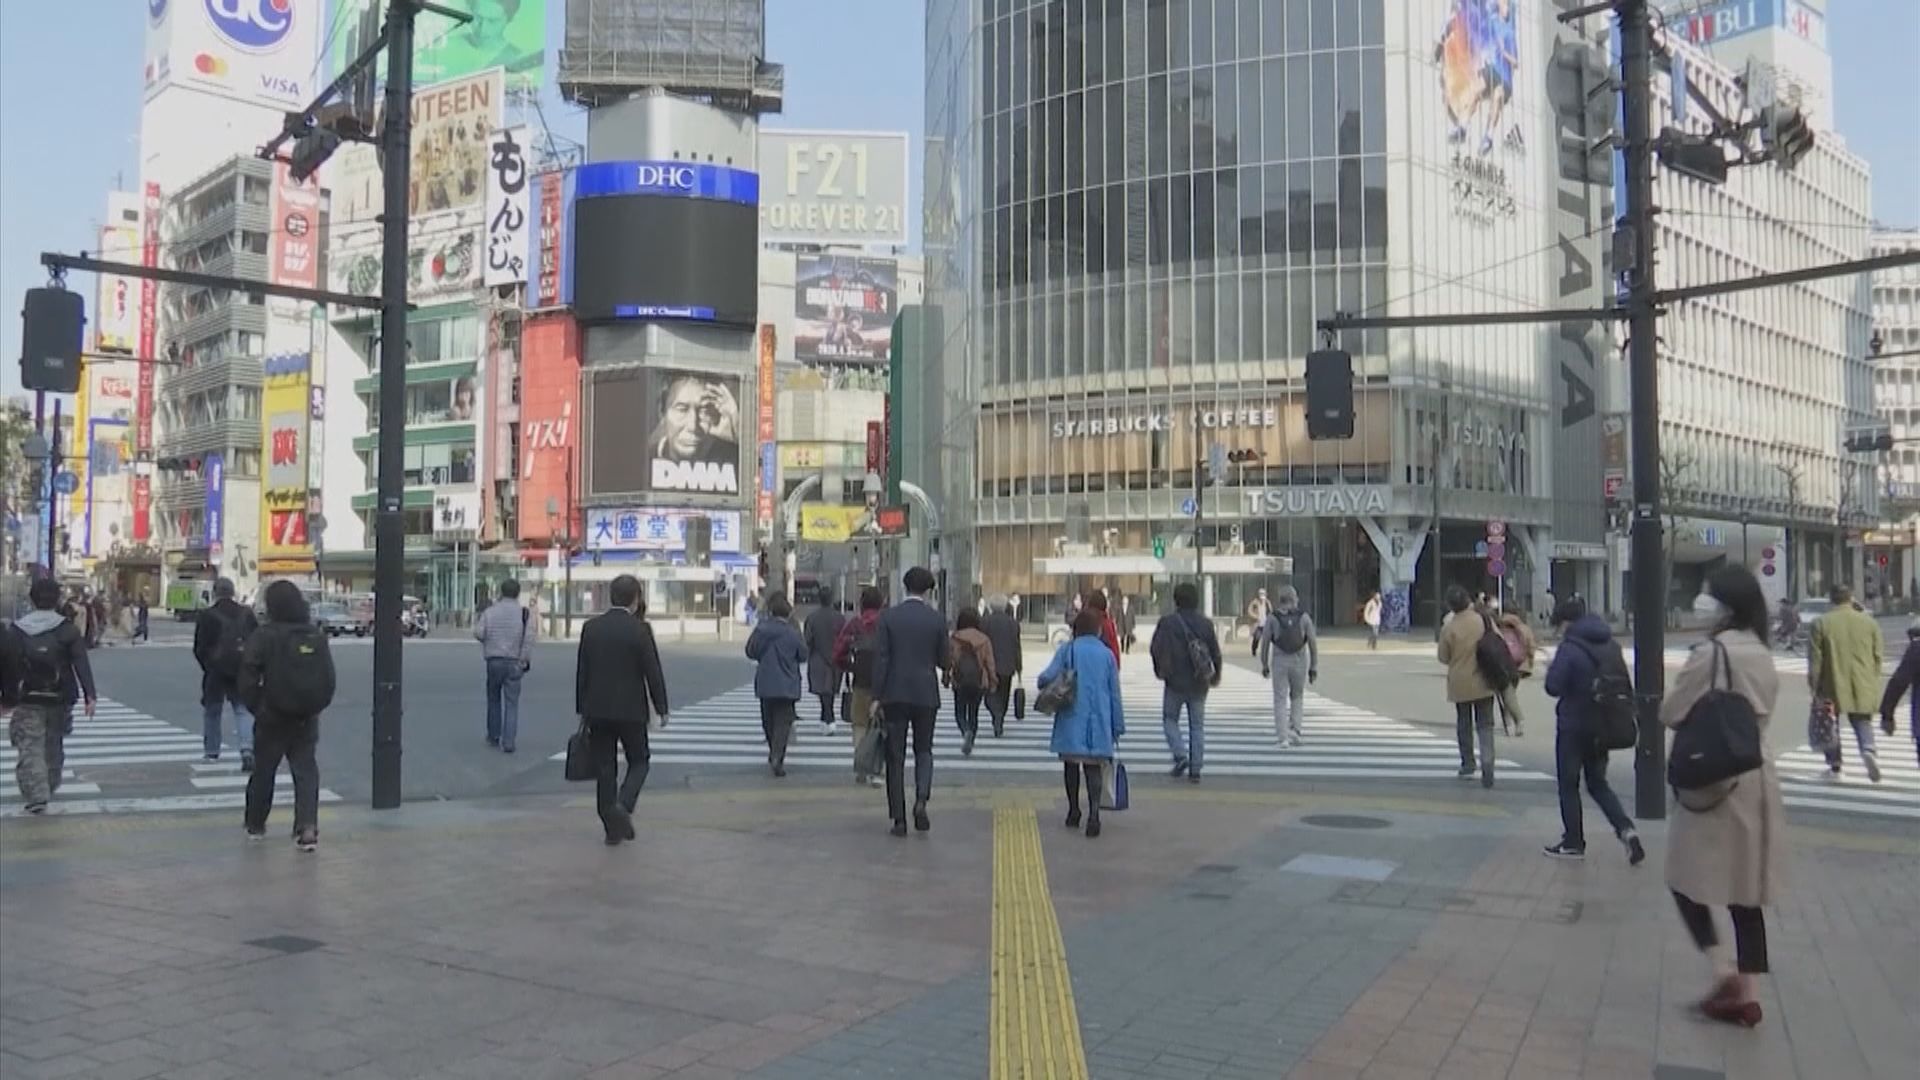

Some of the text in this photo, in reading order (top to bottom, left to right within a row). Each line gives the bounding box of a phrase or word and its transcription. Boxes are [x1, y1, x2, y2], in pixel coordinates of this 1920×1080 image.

[261, 74, 300, 96] VISA
[638, 166, 695, 189] DHC
[787, 142, 867, 198] F21
[490, 130, 525, 278] もんじゃ
[874, 204, 900, 233] 21
[1052, 412, 1176, 438] STARBUCKS
[651, 458, 738, 492] DMM
[1246, 488, 1386, 515] TSUTAYA
